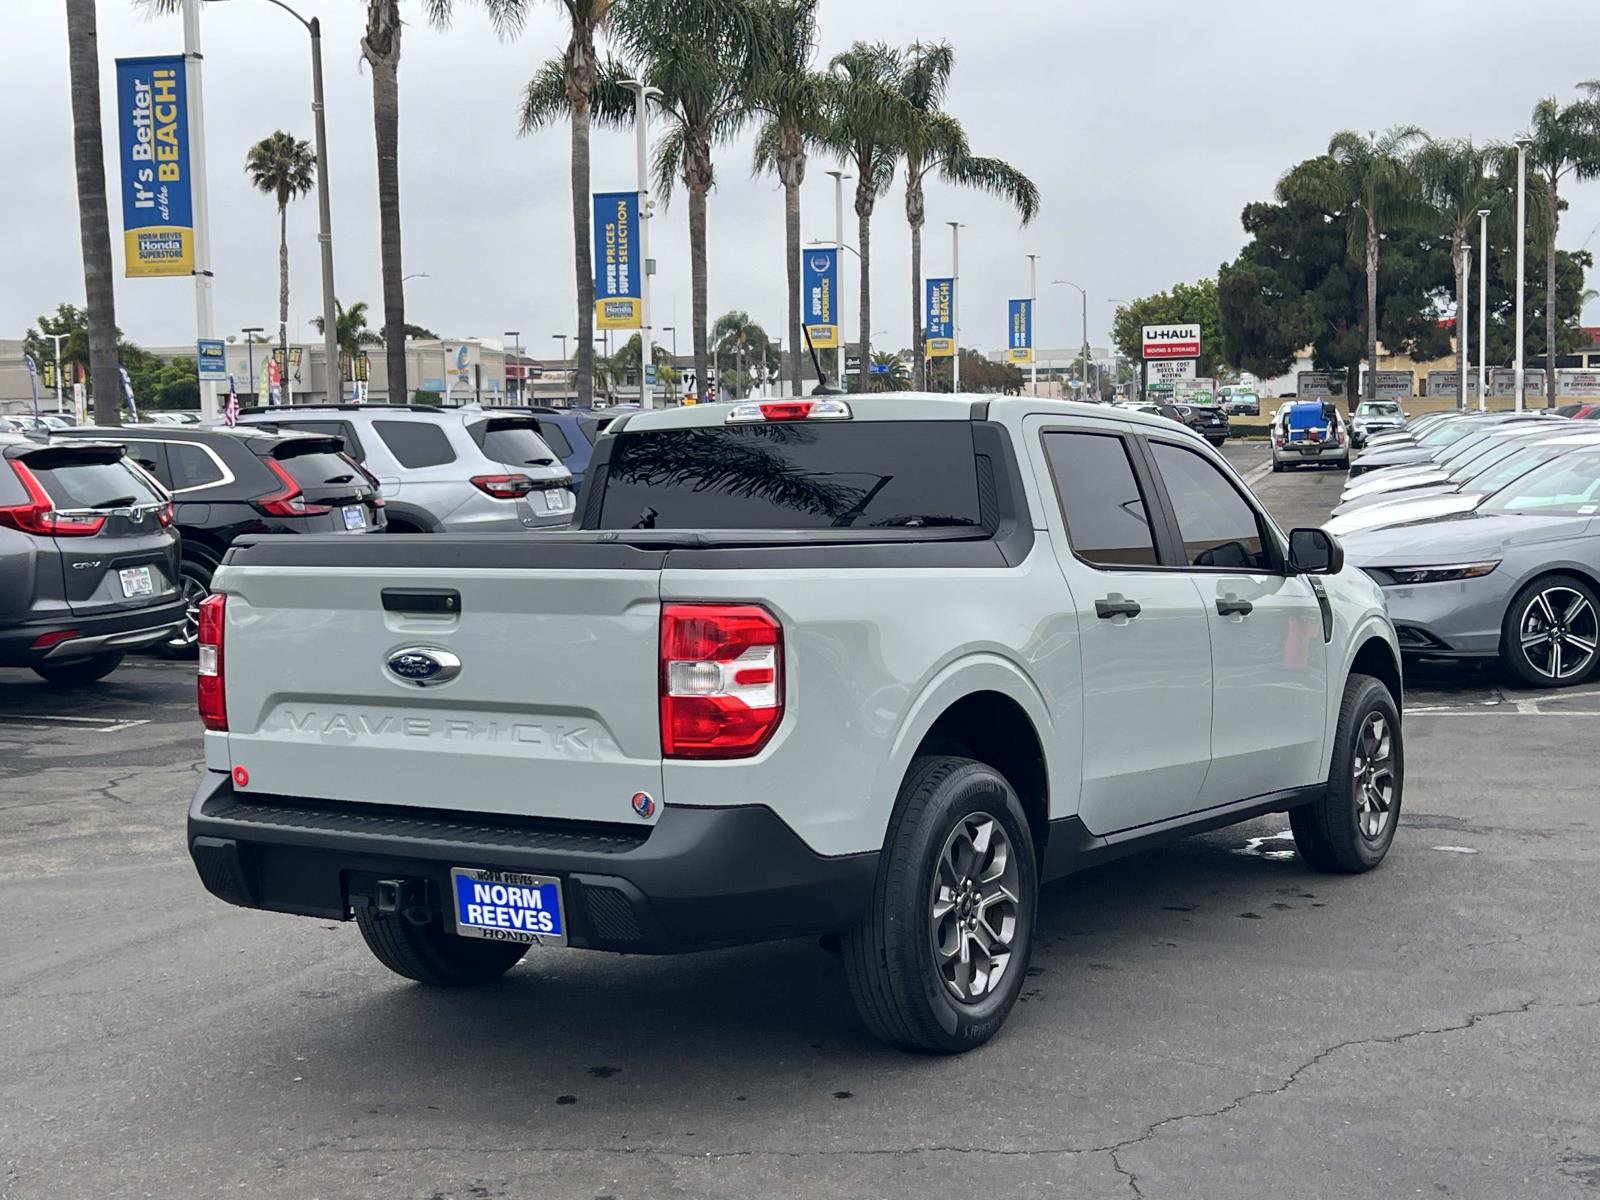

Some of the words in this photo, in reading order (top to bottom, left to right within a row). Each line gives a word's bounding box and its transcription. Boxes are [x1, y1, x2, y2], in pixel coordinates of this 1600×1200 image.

[132, 79, 153, 160] Better
[153, 70, 180, 181] BEACH!
[134, 168, 154, 208] It's
[156, 185, 168, 205] the
[138, 232, 158, 240] NORM
[160, 232, 182, 240] REEVES
[141, 240, 180, 250] Honda
[606, 223, 615, 263] PRICES
[618, 201, 628, 263] SELECTION
[139, 250, 183, 259] SUPERSTORE
[607, 264, 616, 294] SUPER
[619, 263, 629, 294] SUPER
[606, 305, 632, 314] Honda
[812, 287, 821, 316] SUPER
[930, 286, 940, 315] Better
[940, 283, 949, 323] BEACH!
[930, 317, 939, 332] It's
[1146, 329, 1196, 339] U-HAUL
[398, 655, 431, 673] Ford
[284, 710, 591, 749] MAVERICK
[476, 870, 501, 882] NORM
[504, 873, 533, 886] REEVES
[473, 883, 543, 909] NORM
[467, 903, 554, 932] REEVES
[483, 928, 542, 945] HONDA
